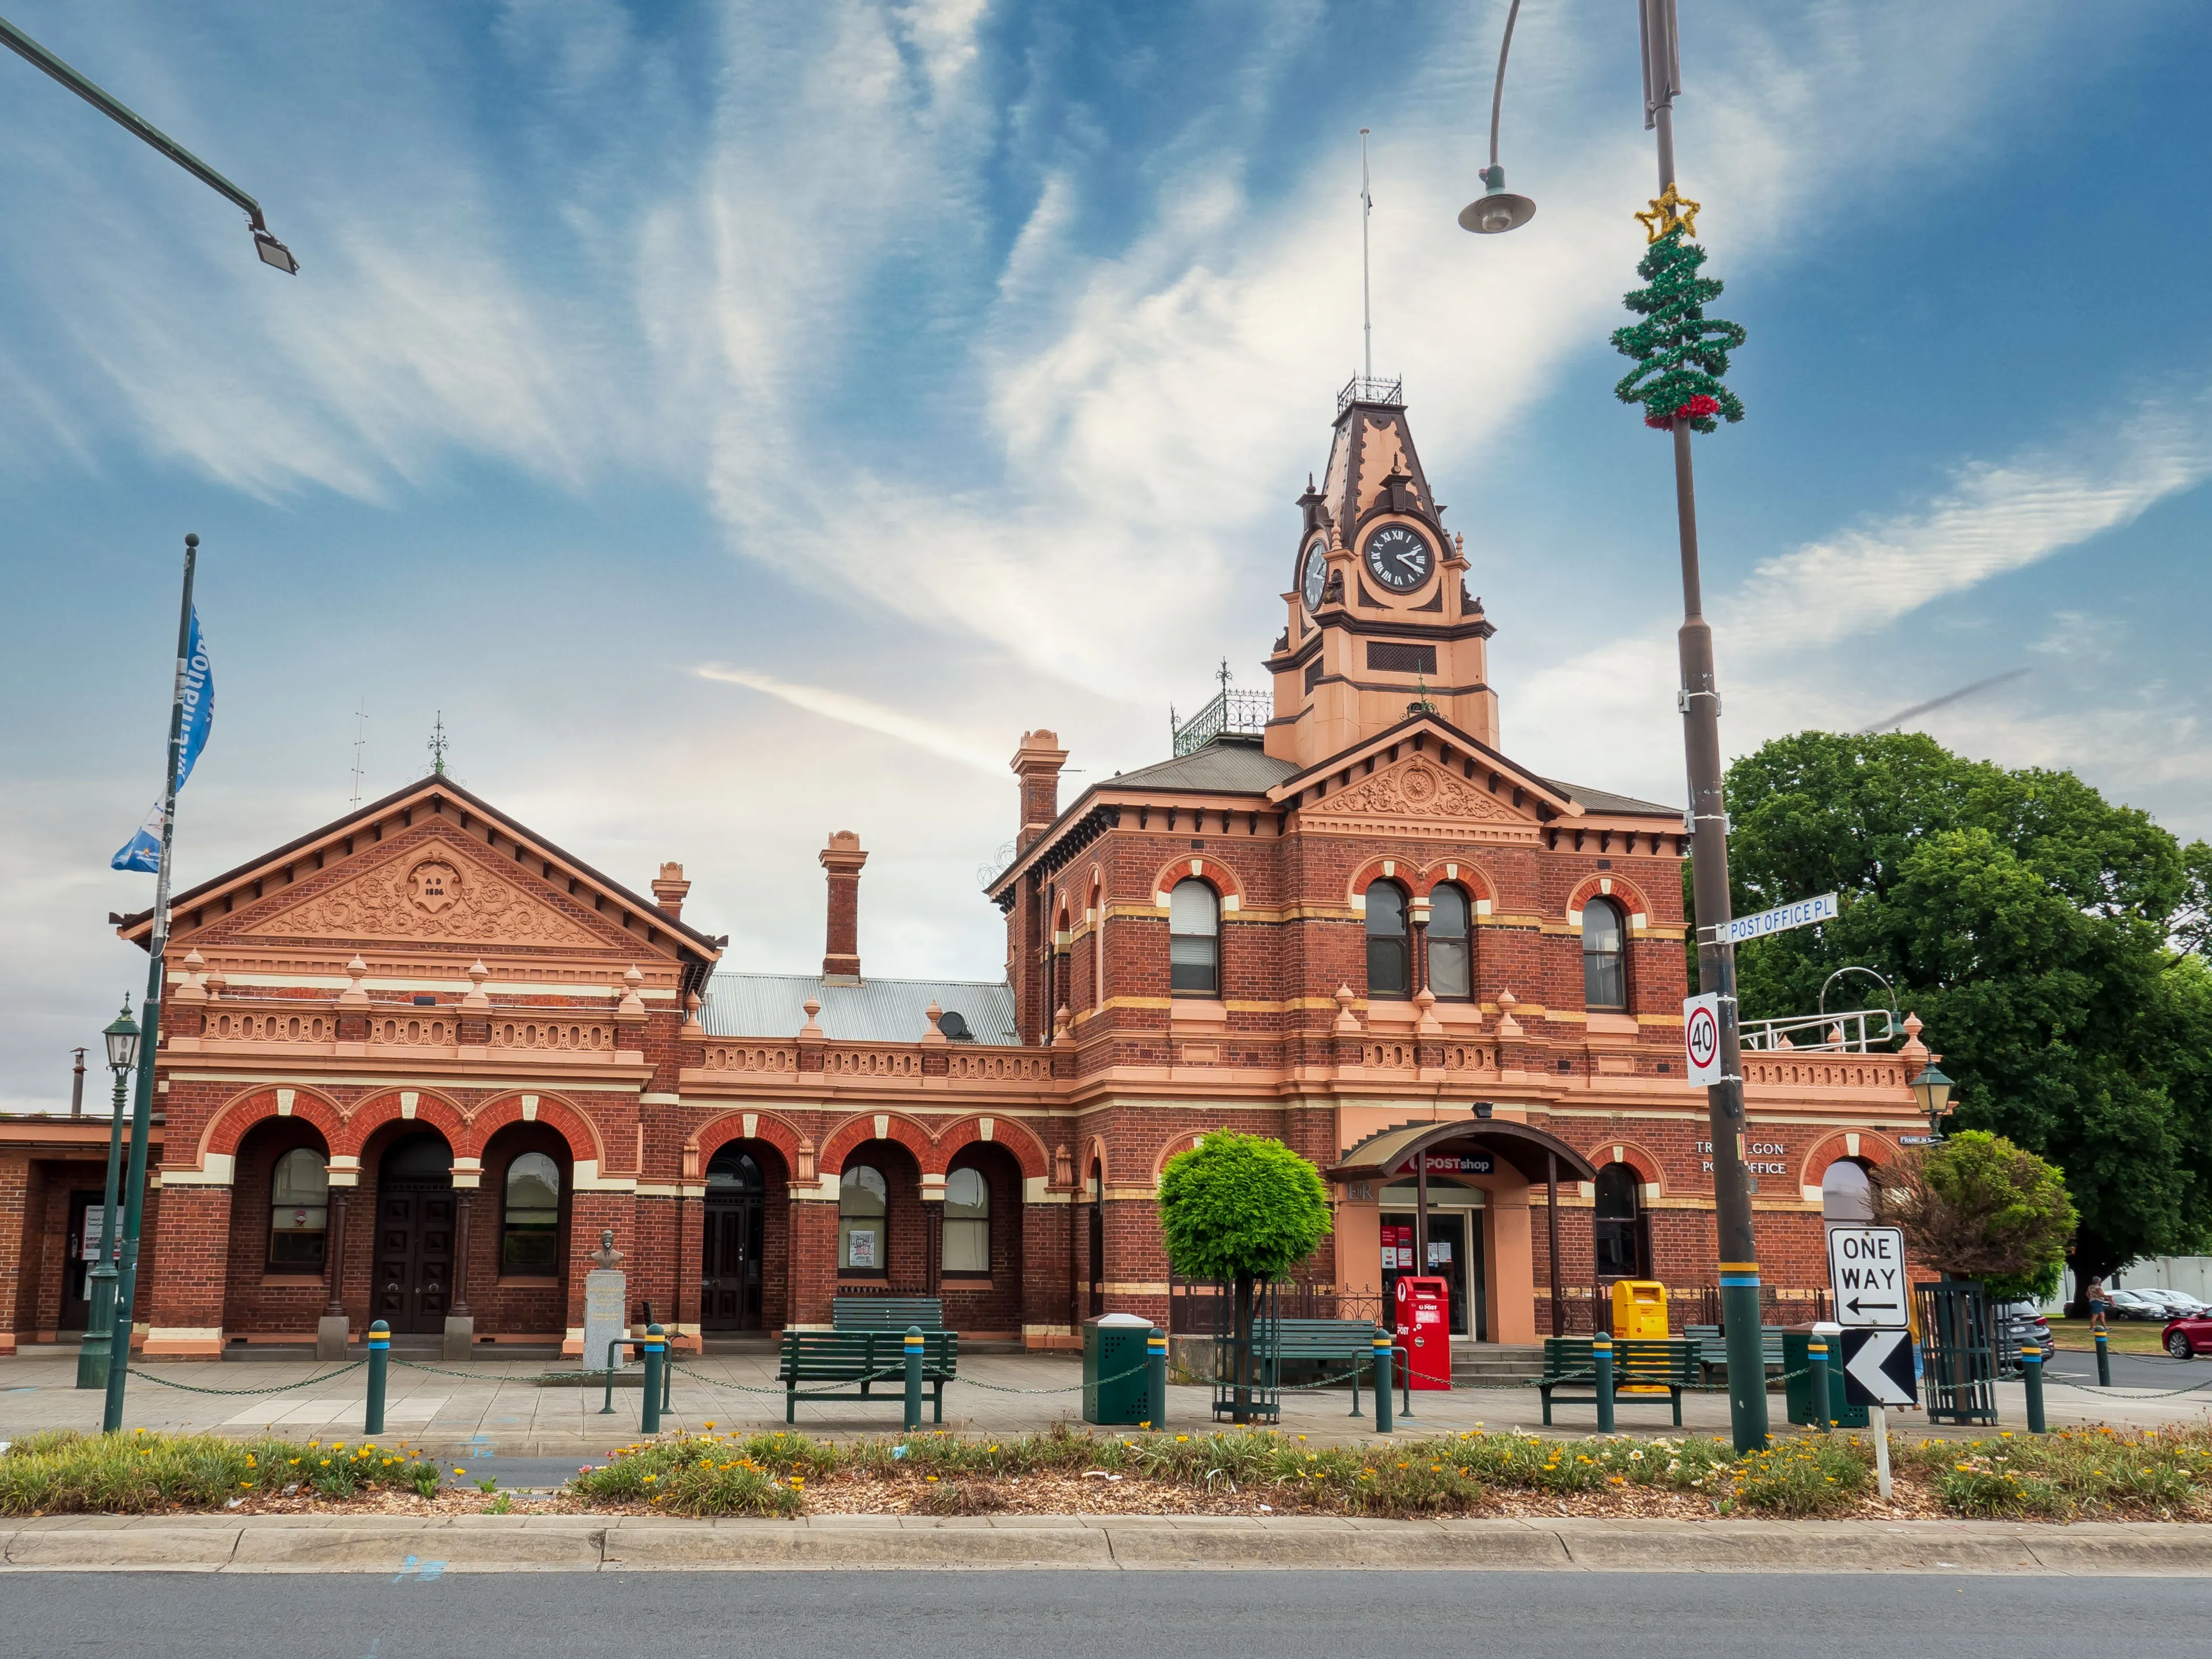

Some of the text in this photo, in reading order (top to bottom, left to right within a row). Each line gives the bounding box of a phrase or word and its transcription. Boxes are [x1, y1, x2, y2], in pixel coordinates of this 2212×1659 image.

[1380, 532, 1392, 543] XI
[1392, 530, 1403, 540] XII
[1406, 535, 1412, 543] I
[1373, 540, 1384, 550] X
[1371, 551, 1380, 559] IX
[1416, 555, 1425, 565] III
[1373, 561, 1384, 574] VIII
[1381, 570, 1392, 582] VII
[1394, 575, 1403, 585] VI
[1407, 574, 1415, 583] V
[1731, 899, 1831, 940] POST OFFICE PL
[1692, 1021, 1712, 1052] 40
[1695, 1141, 1783, 1154] TRGON
[1748, 1162, 1786, 1174] FFICE
[1843, 1238, 1891, 1259] ONE
[1841, 1268, 1895, 1289] WAY
[1397, 1326, 1409, 1335] POST
